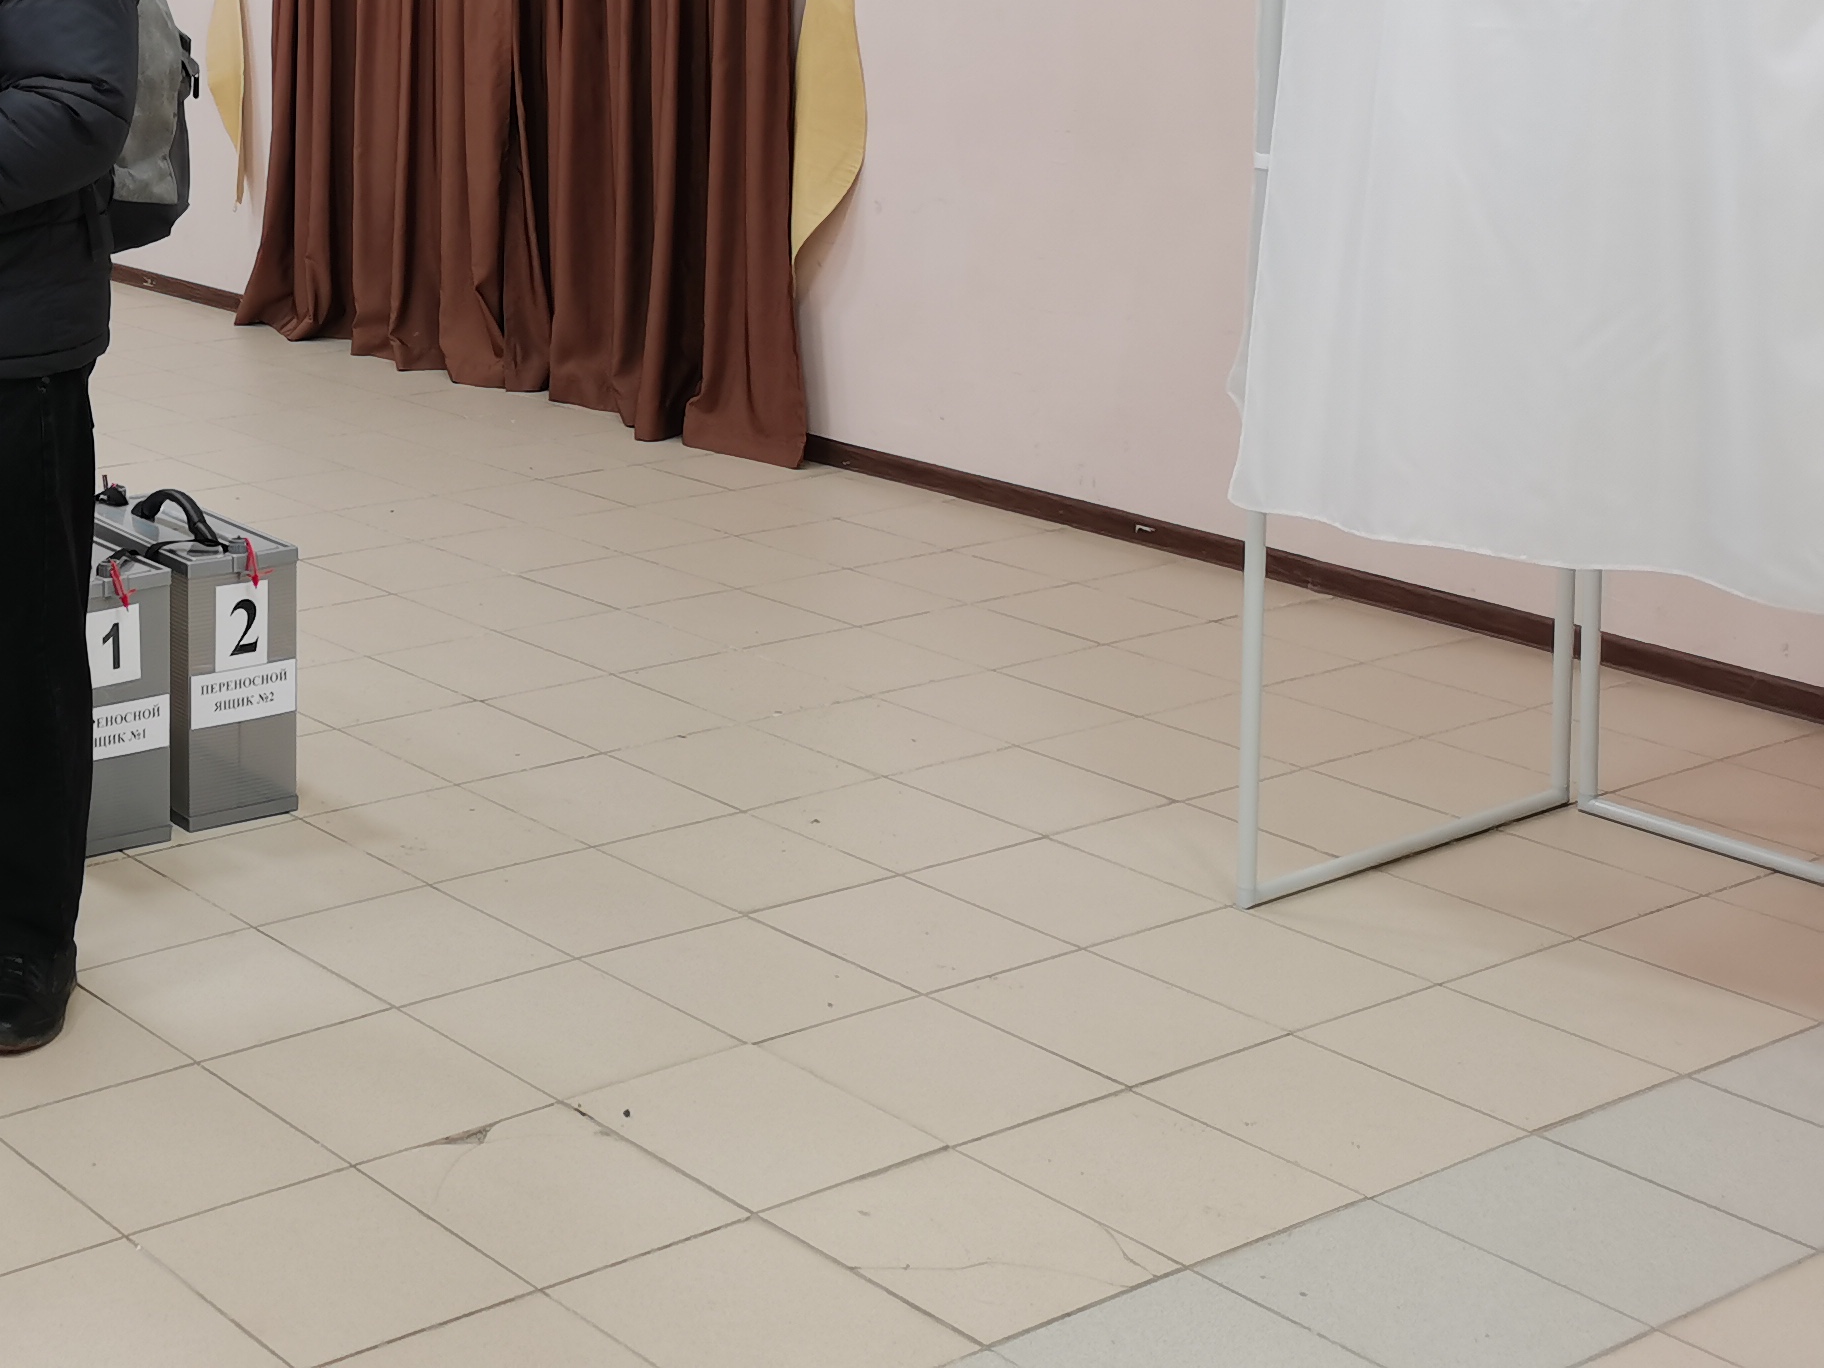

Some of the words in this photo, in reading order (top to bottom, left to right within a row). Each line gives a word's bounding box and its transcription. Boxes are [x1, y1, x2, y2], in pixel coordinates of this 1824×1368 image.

[229, 599, 259, 657] 2
[102, 622, 120, 670] 1
[200, 667, 288, 696] ПЕРЕНОСНОЙ
[214, 694, 255, 712] ЯЩИК
[256, 691, 275, 705] №2
[93, 703, 160, 729] ЕНОСНОЙ
[94, 732, 126, 748] ЩИК
